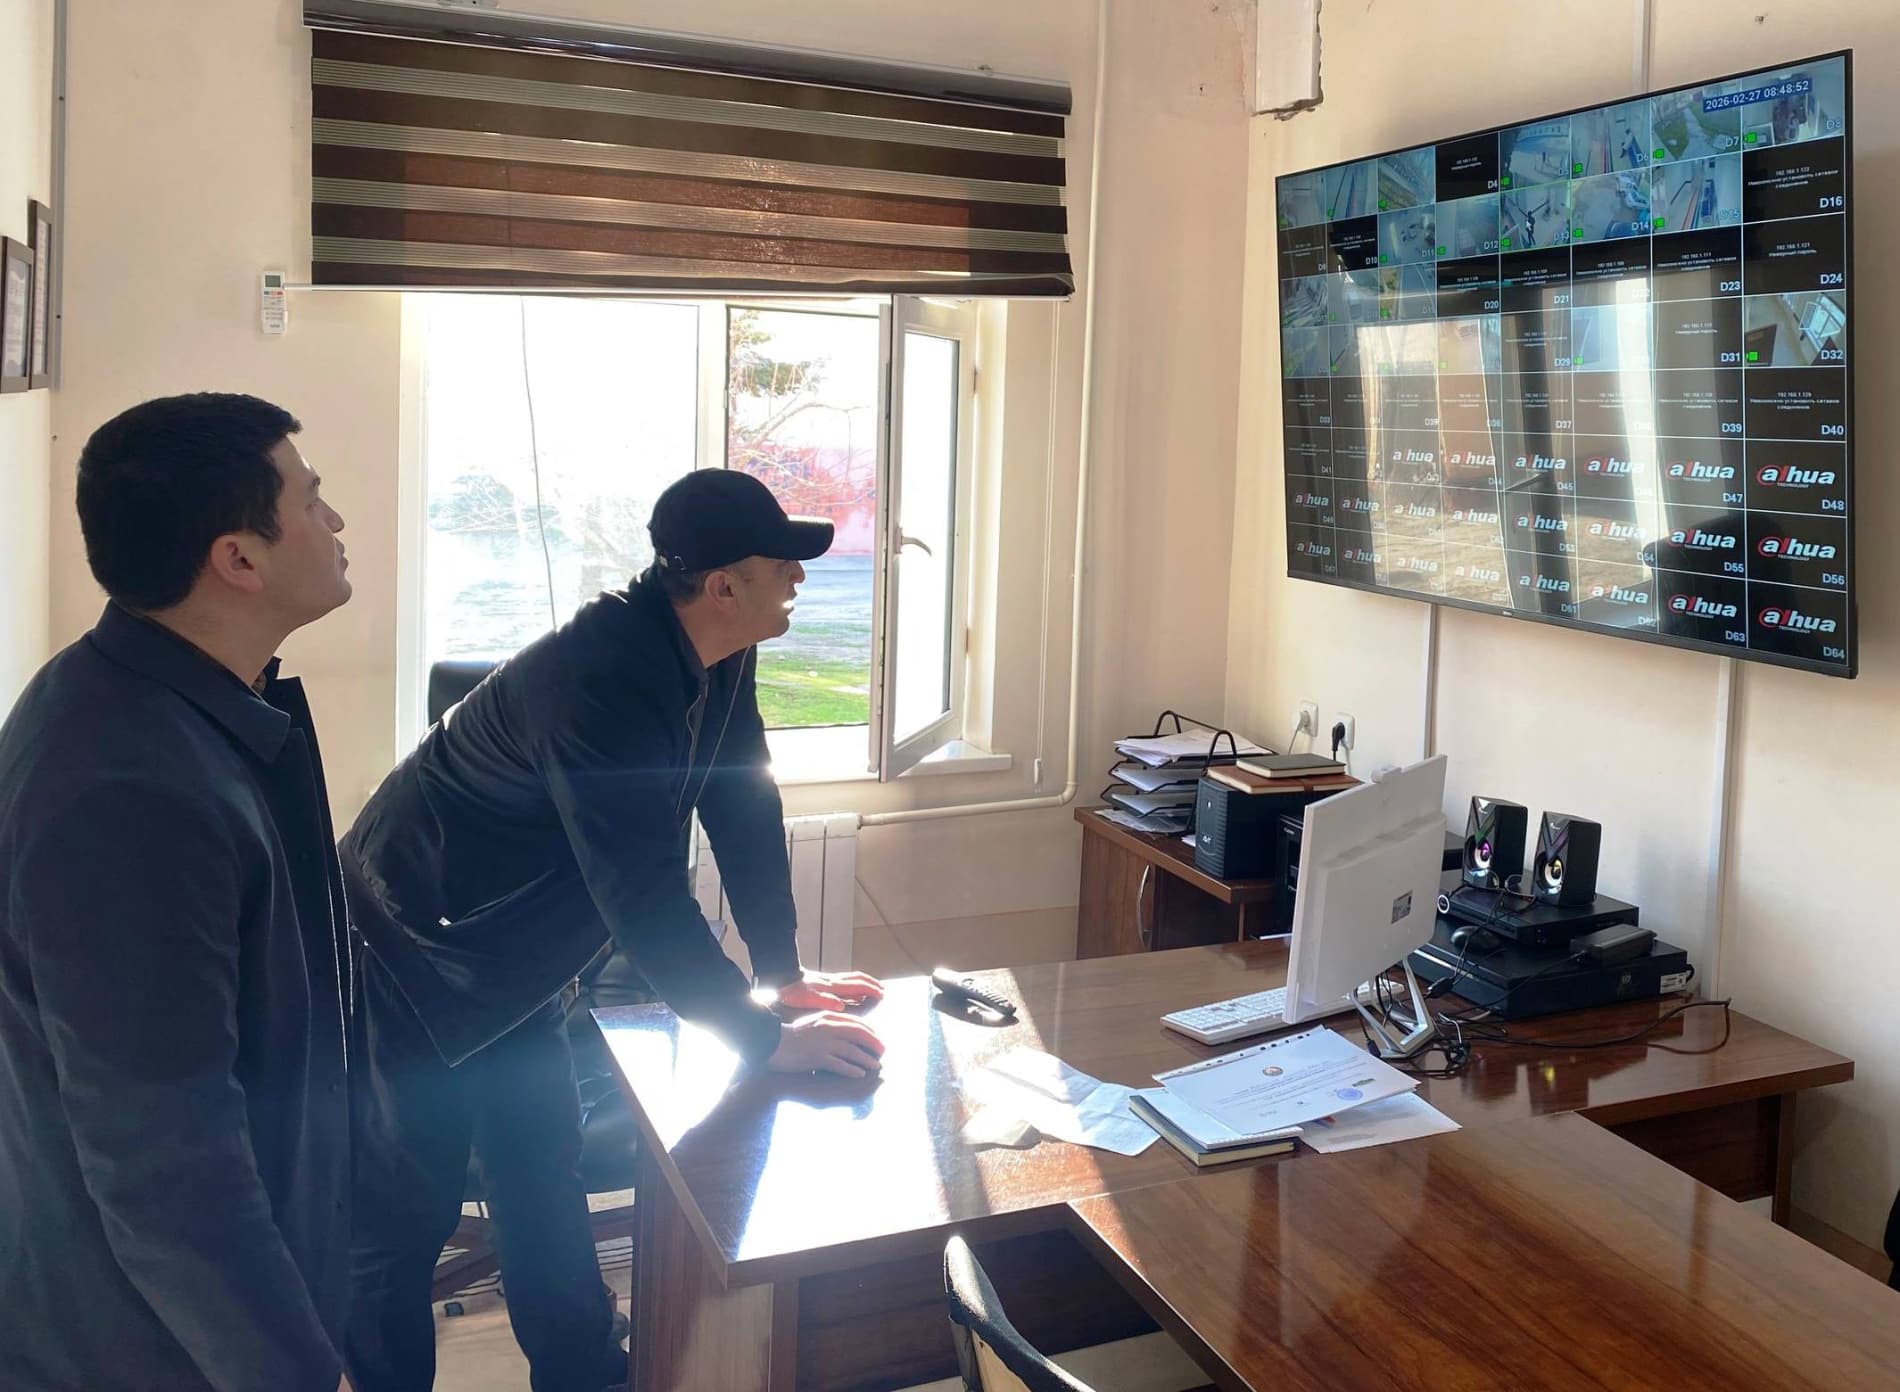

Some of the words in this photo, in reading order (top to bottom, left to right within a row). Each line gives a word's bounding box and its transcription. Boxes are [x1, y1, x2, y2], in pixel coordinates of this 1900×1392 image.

[1705, 90, 1760, 110] 2026-02-27
[1763, 80, 1809, 98] 08:48:52
[1725, 136, 1739, 148] D7
[1820, 196, 1843, 208] D16
[1631, 221, 1649, 231] D14
[1483, 241, 1498, 250] D12
[1820, 273, 1843, 284] D24
[1720, 281, 1741, 291] D23
[1553, 295, 1569, 304] D21
[1484, 301, 1498, 310] D20
[1721, 352, 1740, 362] D31
[1821, 350, 1843, 360] D32
[1555, 420, 1571, 429] D37
[1722, 423, 1742, 433] D39
[1821, 425, 1844, 435] D40
[1557, 481, 1574, 491] D45
[1723, 493, 1743, 503] D47
[1822, 500, 1845, 511] D48
[1723, 562, 1744, 573] D55
[1822, 573, 1845, 585] D56
[1725, 630, 1745, 642] D63
[1823, 646, 1845, 659] D64
